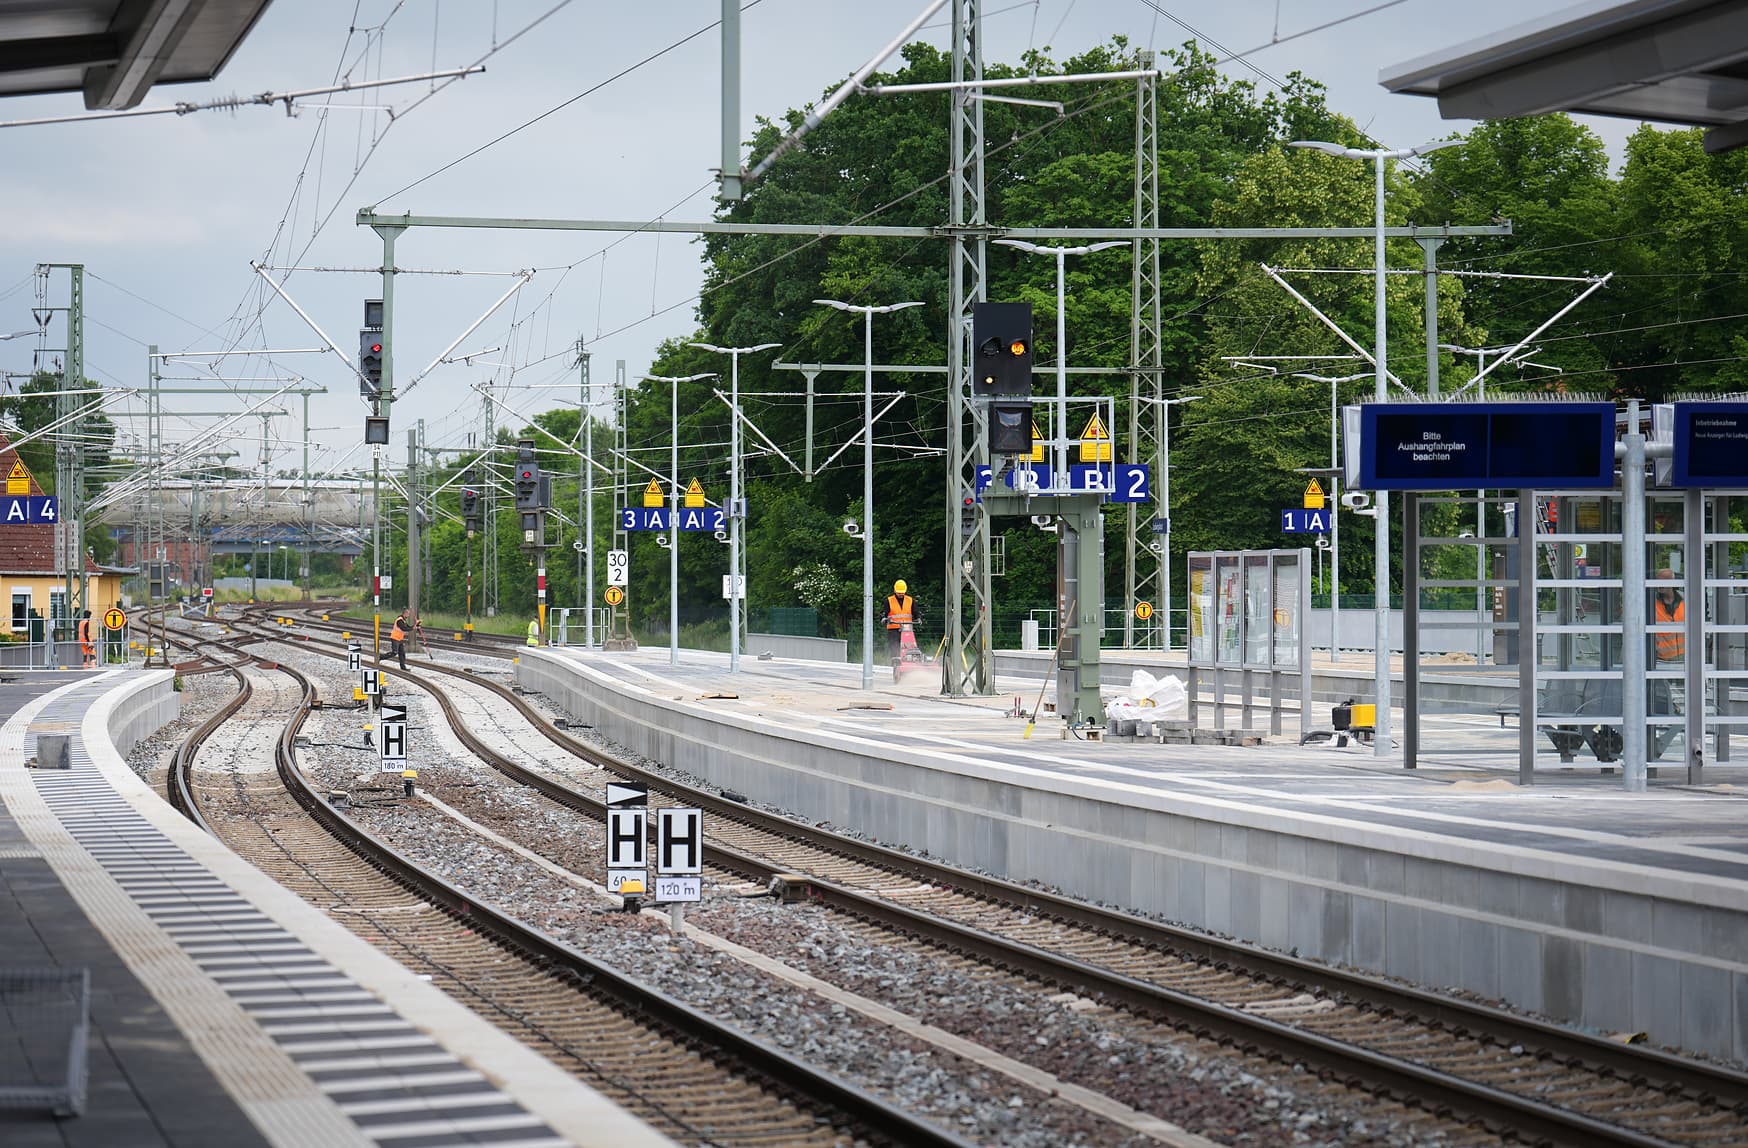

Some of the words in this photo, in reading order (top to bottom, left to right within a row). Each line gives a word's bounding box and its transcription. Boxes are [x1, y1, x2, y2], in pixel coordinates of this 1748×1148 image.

[1423, 432, 1441, 441] Bitte
[1398, 442, 1466, 452] Aushangfahrplan
[1413, 452, 1450, 461] beachten
[1127, 469, 1146, 498] 2
[6, 499, 25, 521] A
[40, 499, 55, 521] 4
[624, 510, 635, 528] 3
[648, 511, 663, 529] A
[685, 510, 700, 529] A
[713, 510, 725, 529] 2
[1284, 512, 1295, 530] 1
[1309, 512, 1324, 530] A
[609, 553, 627, 567] 30
[614, 568, 622, 582] 2
[350, 654, 360, 670] H
[364, 671, 378, 693] H
[384, 725, 404, 756] H
[384, 762, 396, 770] 180
[612, 814, 642, 862] H
[663, 814, 697, 868] H
[661, 884, 680, 896] 120
[684, 886, 695, 896] m
